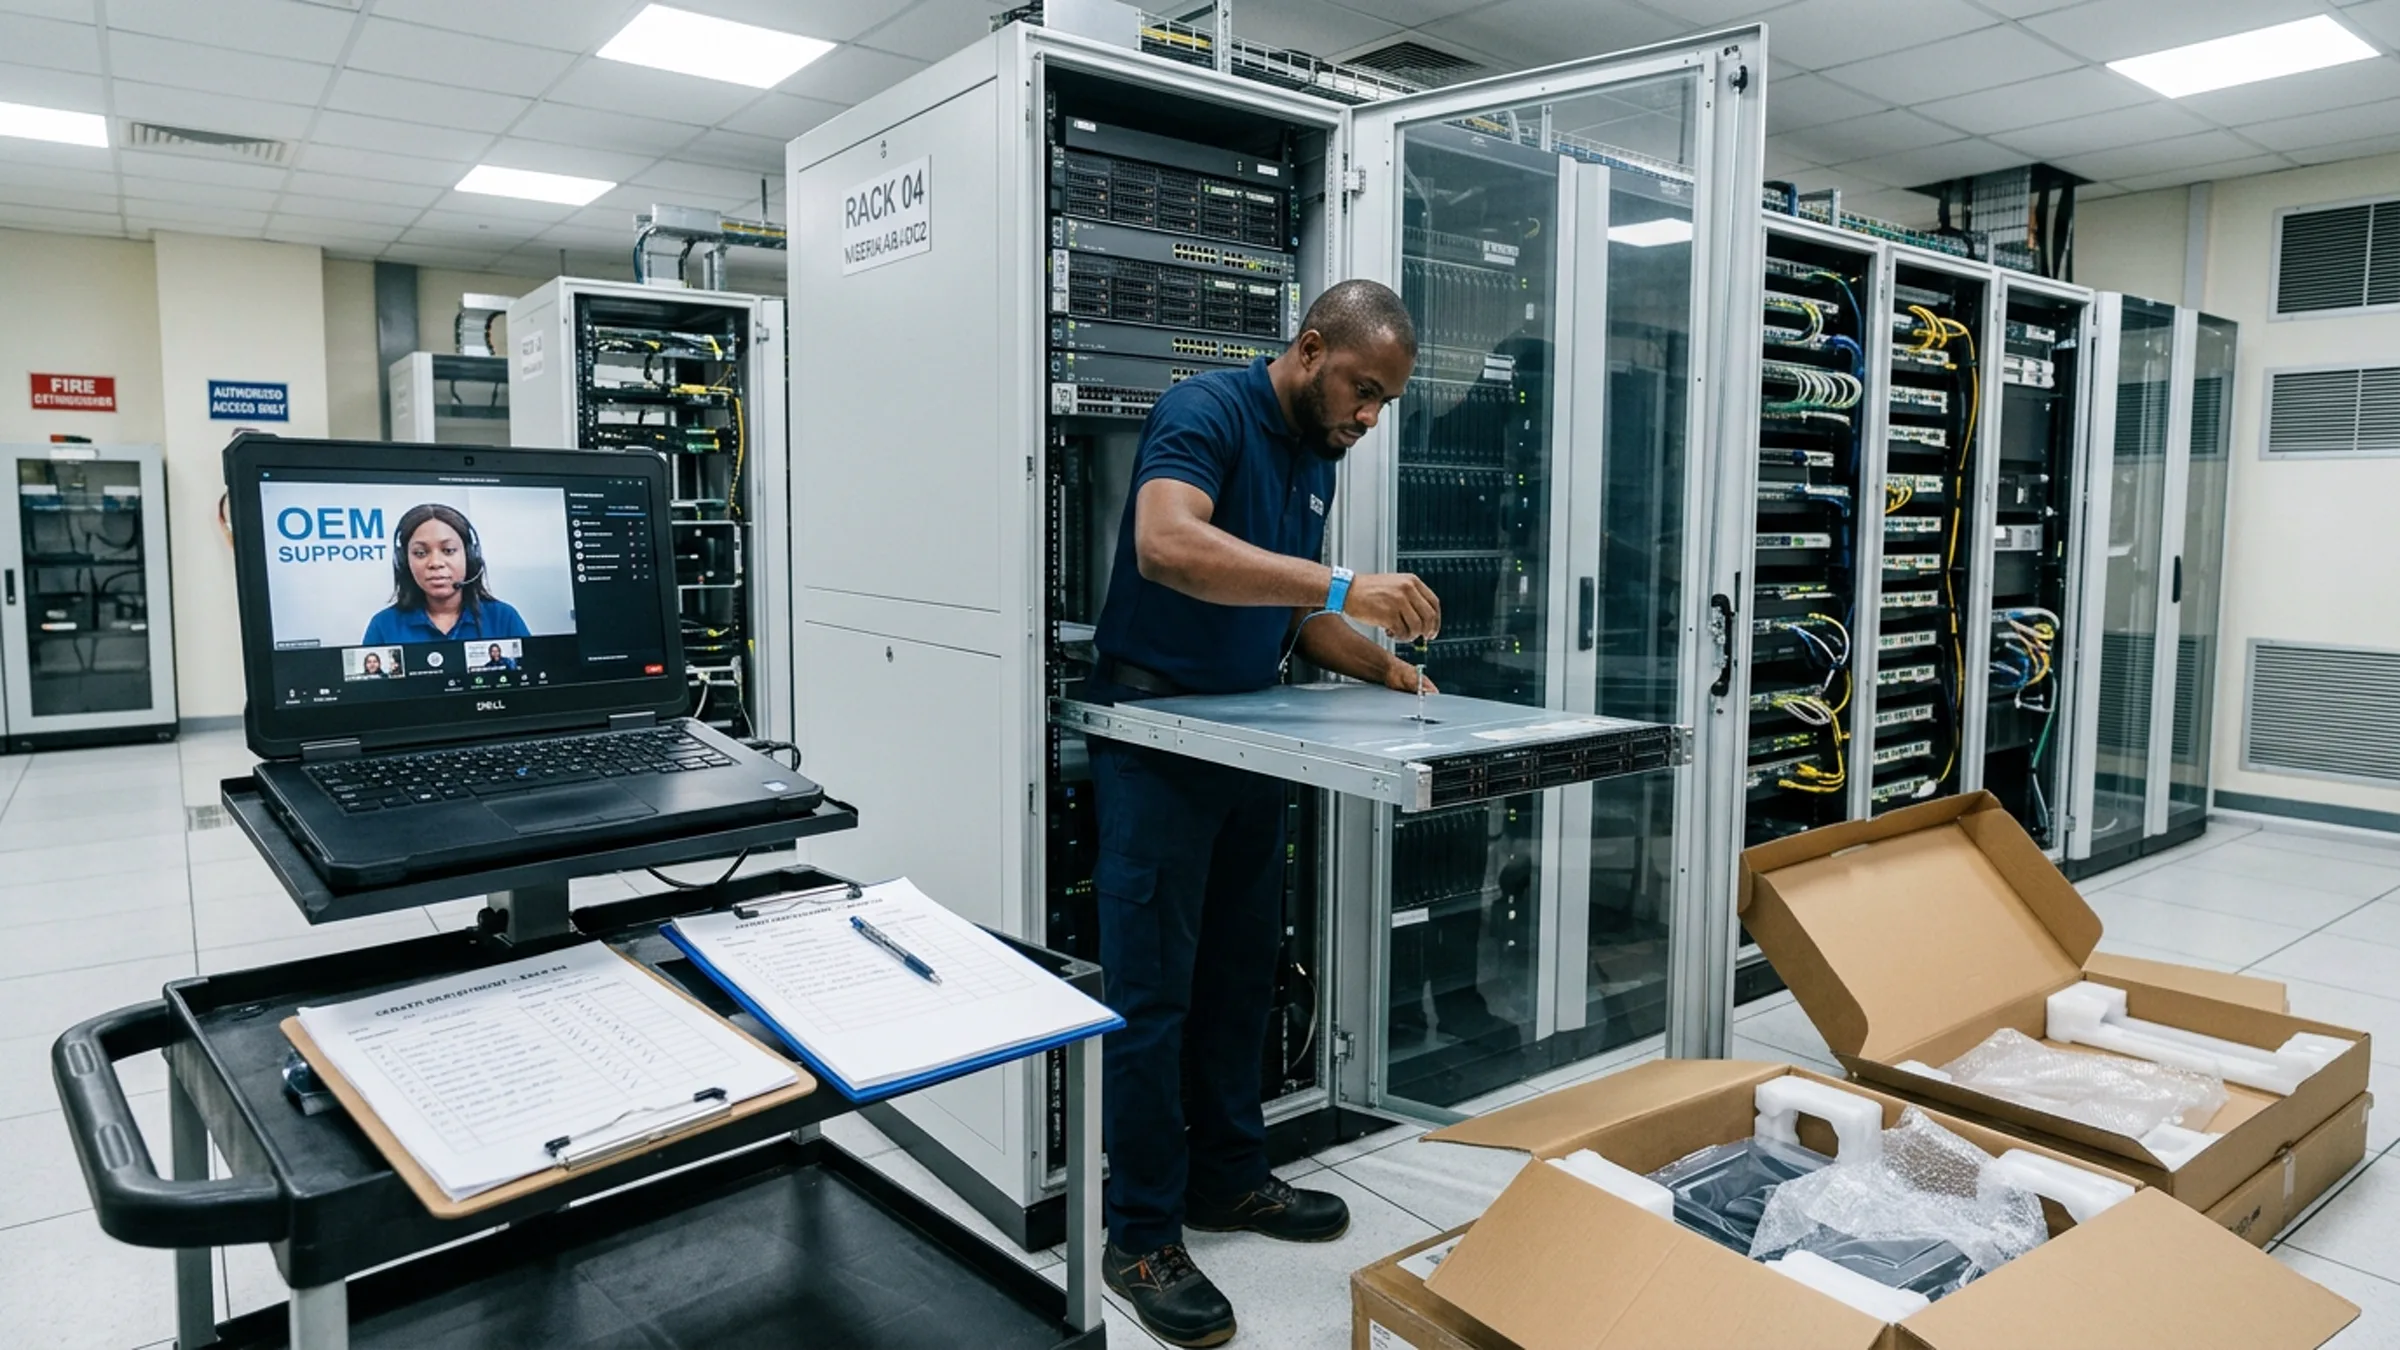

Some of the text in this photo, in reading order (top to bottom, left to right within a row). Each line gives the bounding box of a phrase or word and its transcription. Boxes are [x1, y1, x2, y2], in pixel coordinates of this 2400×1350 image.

[845, 168, 924, 229] RACK 04
[51, 378, 96, 394] FIRE
[277, 507, 385, 540] OEM
[279, 545, 386, 562] SUPPORT
